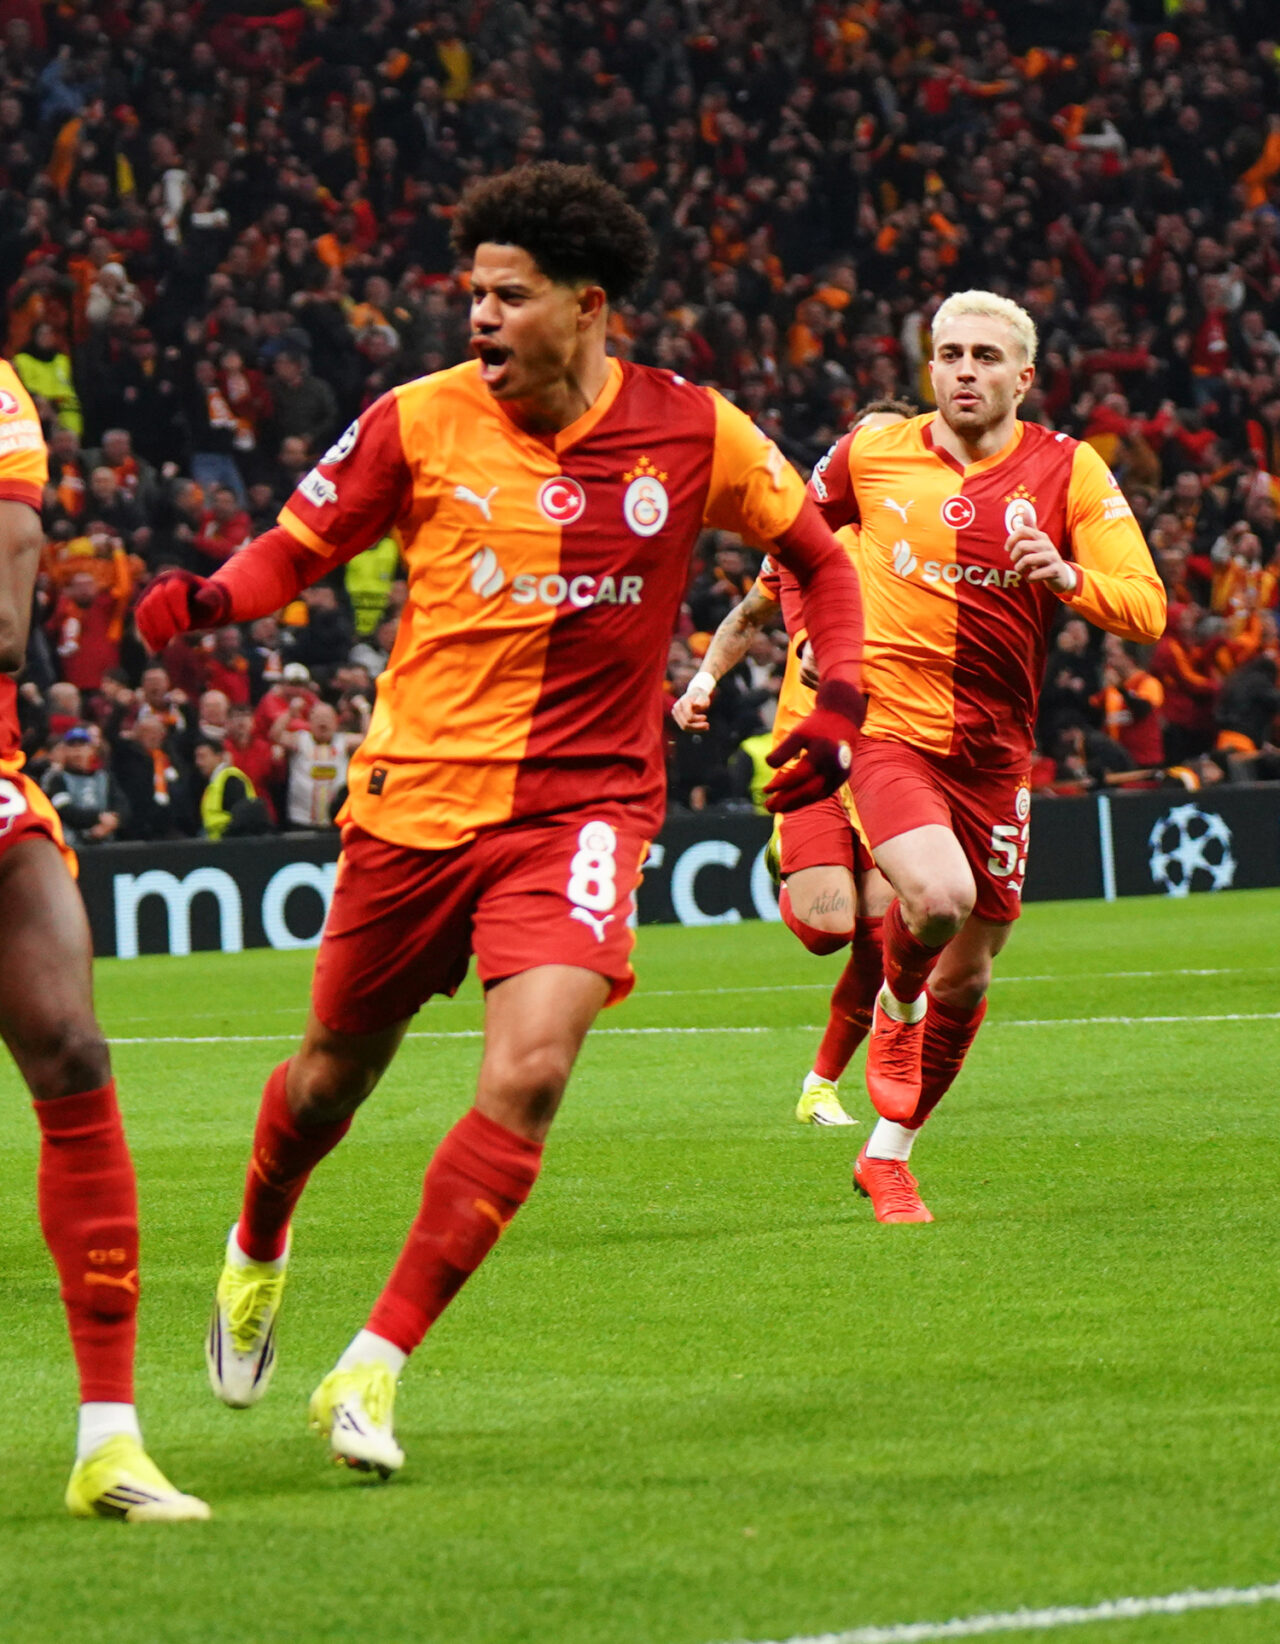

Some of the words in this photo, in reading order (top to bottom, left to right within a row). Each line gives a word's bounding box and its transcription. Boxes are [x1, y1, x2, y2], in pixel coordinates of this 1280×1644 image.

[923, 560, 1023, 588] SOCAR
[511, 575, 644, 607] SOCAR
[567, 850, 616, 912] 8
